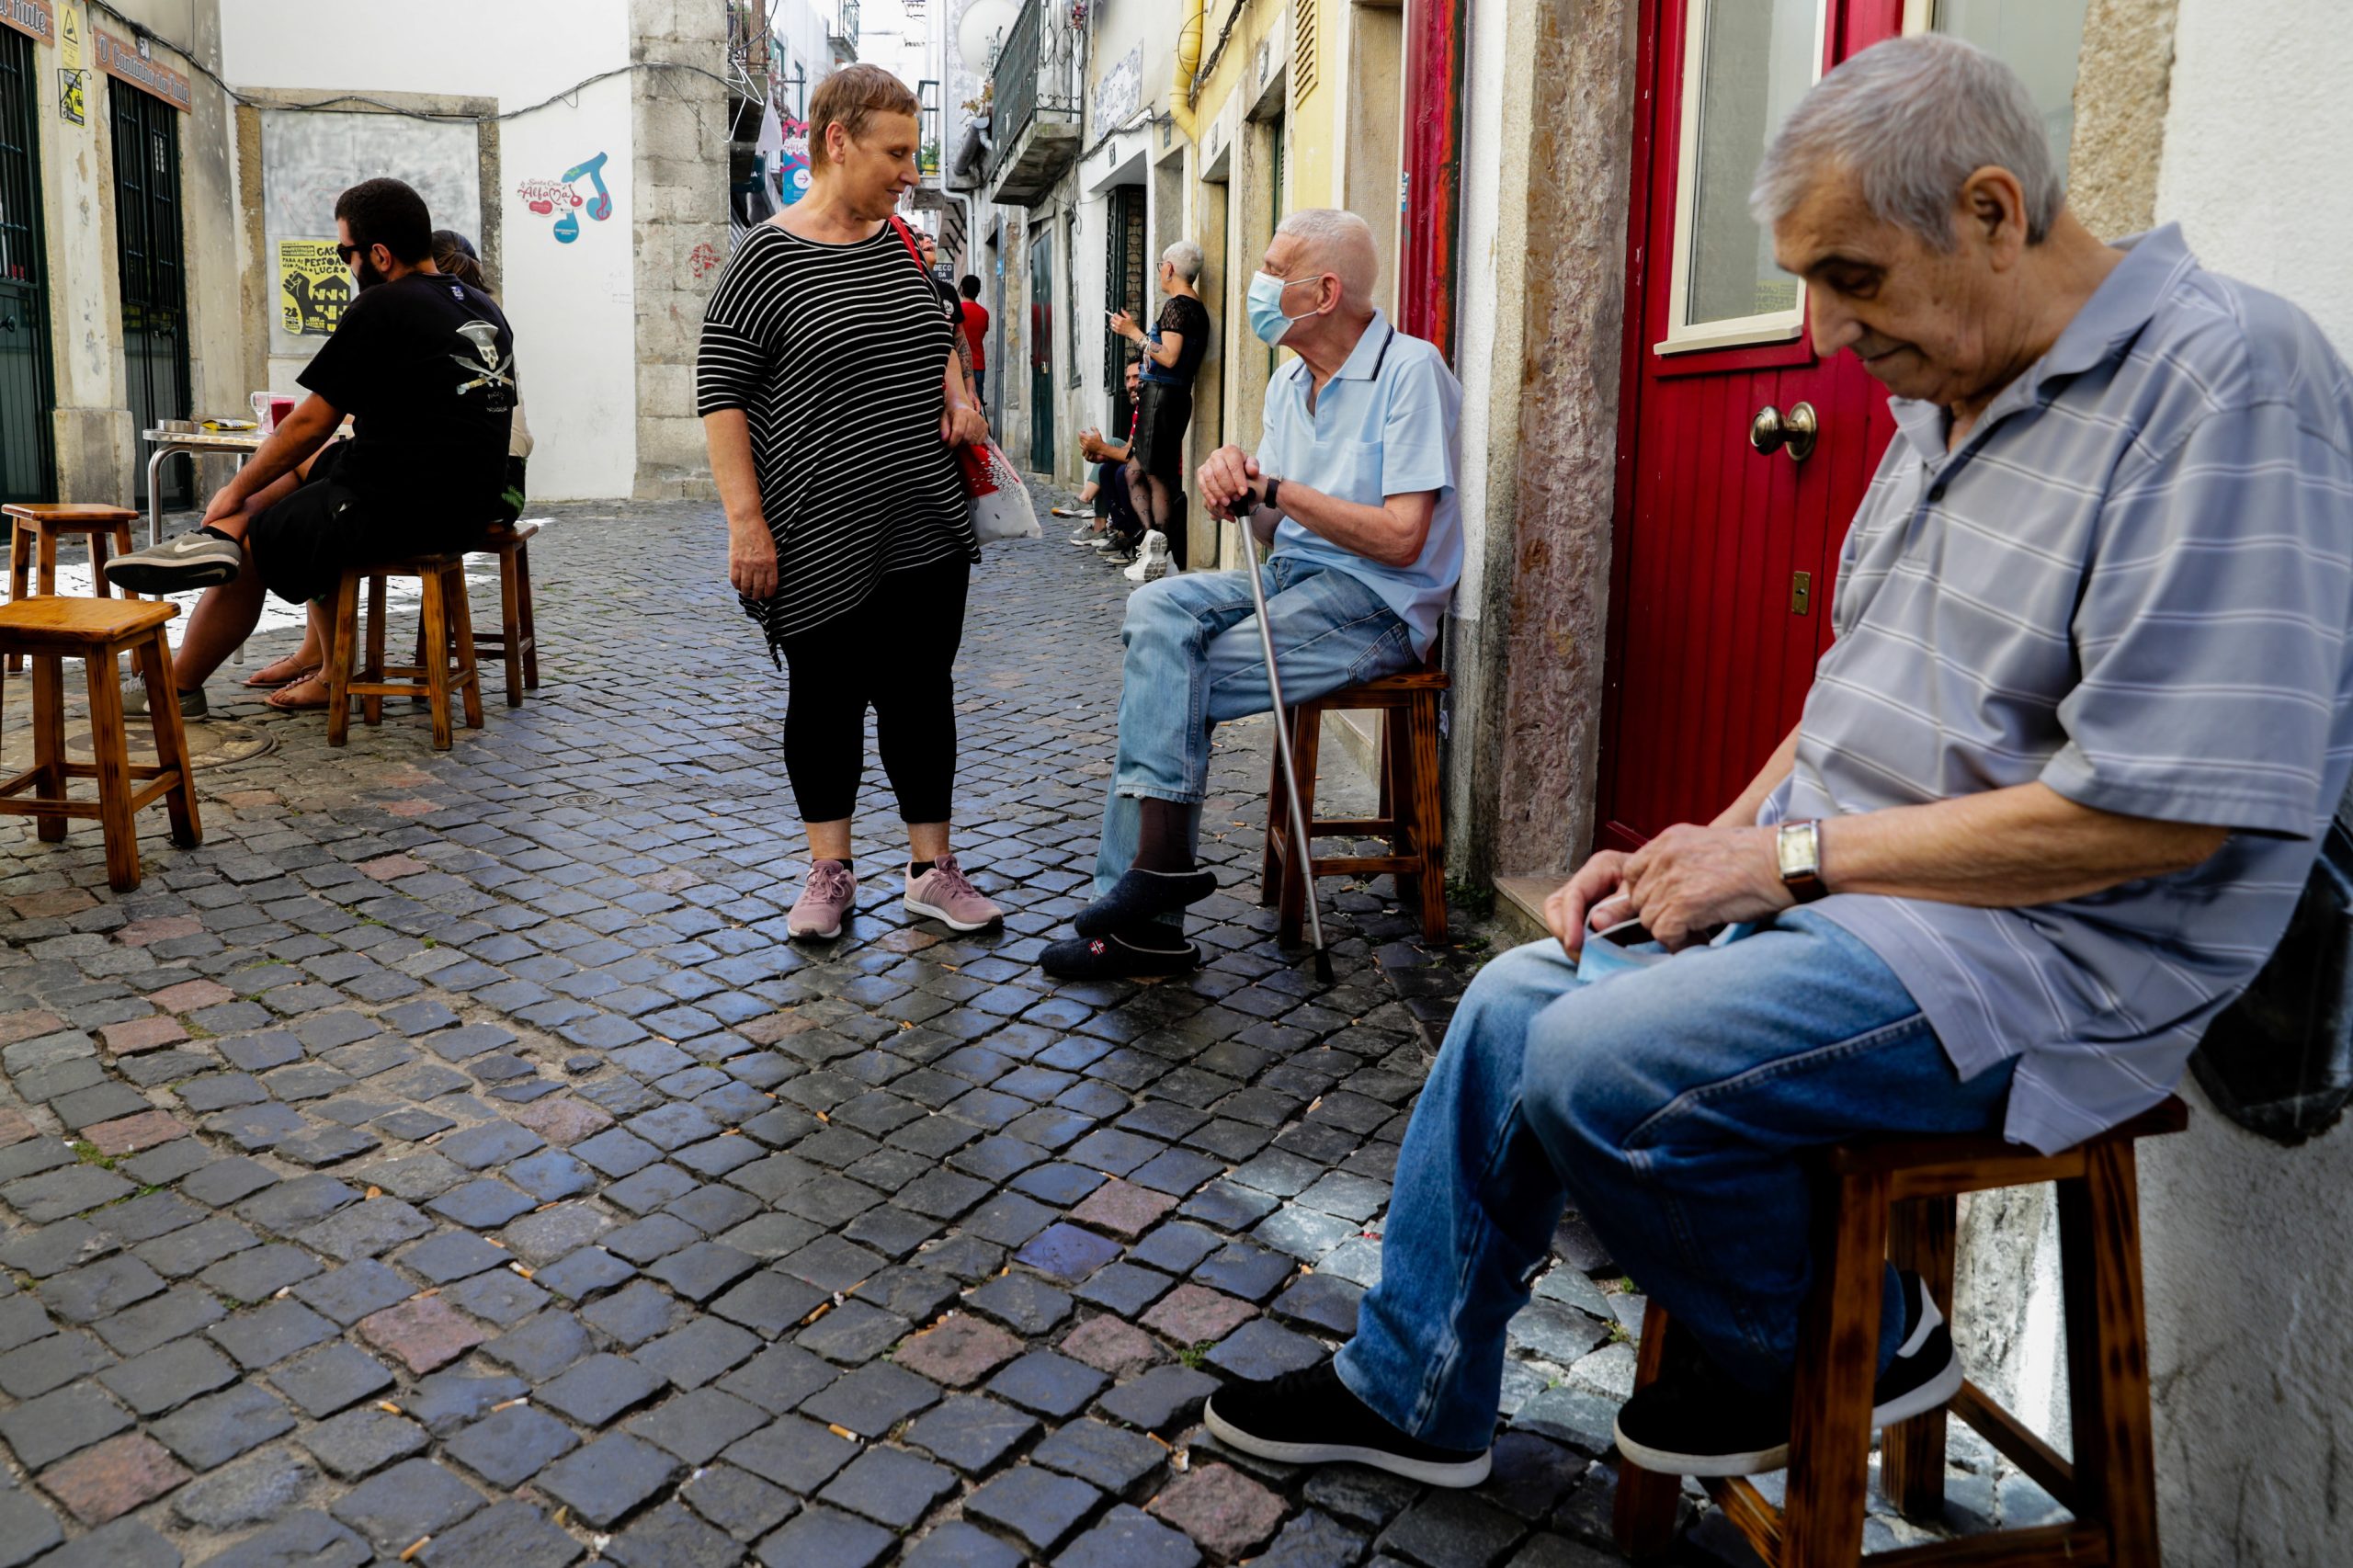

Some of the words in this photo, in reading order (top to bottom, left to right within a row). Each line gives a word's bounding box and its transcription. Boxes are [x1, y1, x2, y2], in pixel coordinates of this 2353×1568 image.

[99, 35, 108, 62] O
[113, 43, 155, 87] Cantinho
[155, 70, 169, 95] da
[168, 73, 189, 105] Rute
[305, 258, 344, 266] PESSOA
[314, 267, 347, 275] LUCRO
